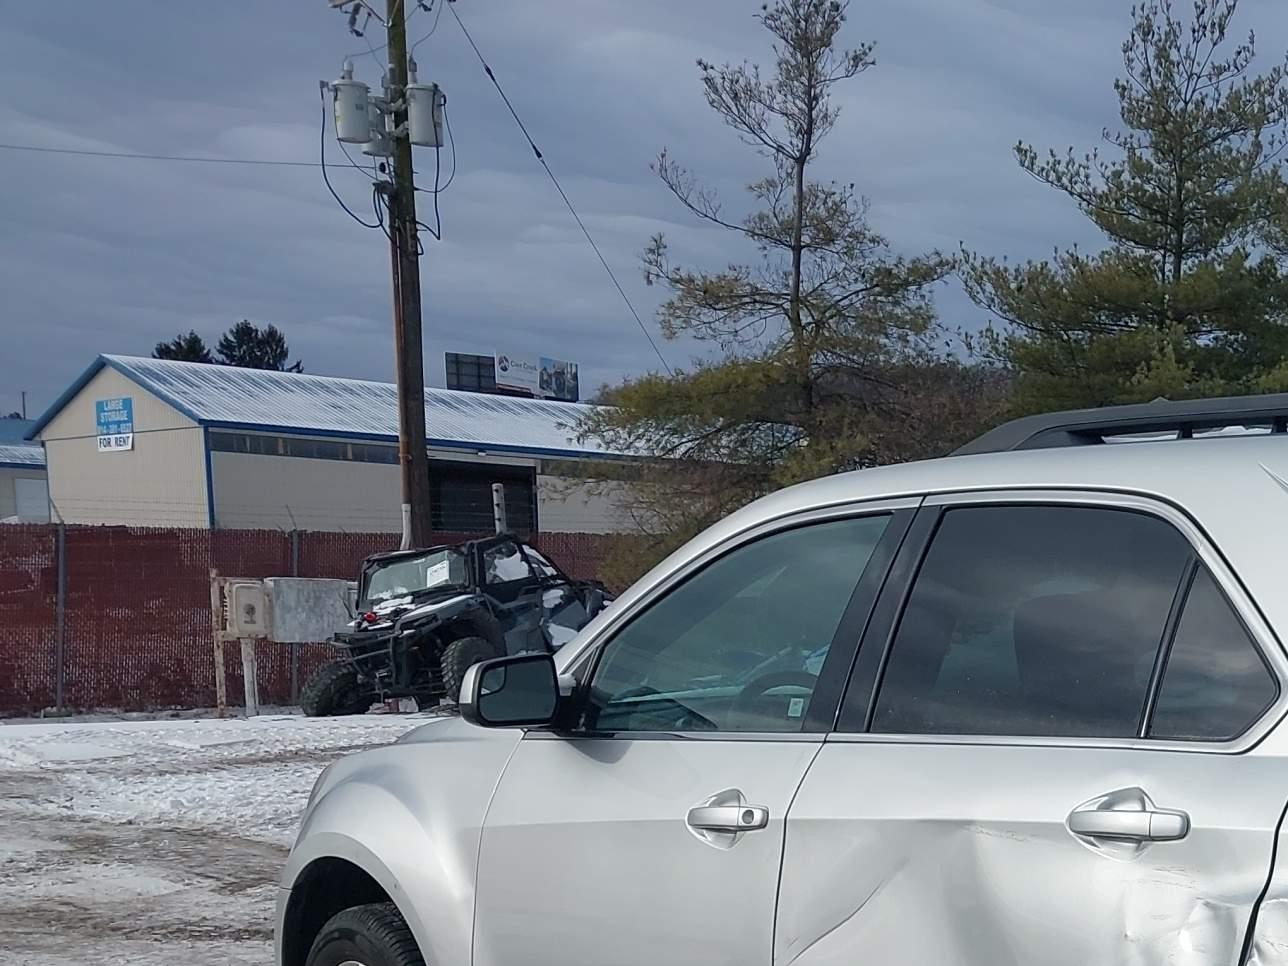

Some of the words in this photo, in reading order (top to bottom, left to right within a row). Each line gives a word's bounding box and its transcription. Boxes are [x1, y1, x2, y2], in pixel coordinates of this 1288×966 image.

[103, 399, 123, 411] LARGE
[100, 410, 128, 423] STORAGE
[99, 437, 111, 448] FOR
[114, 435, 130, 447] RENT
